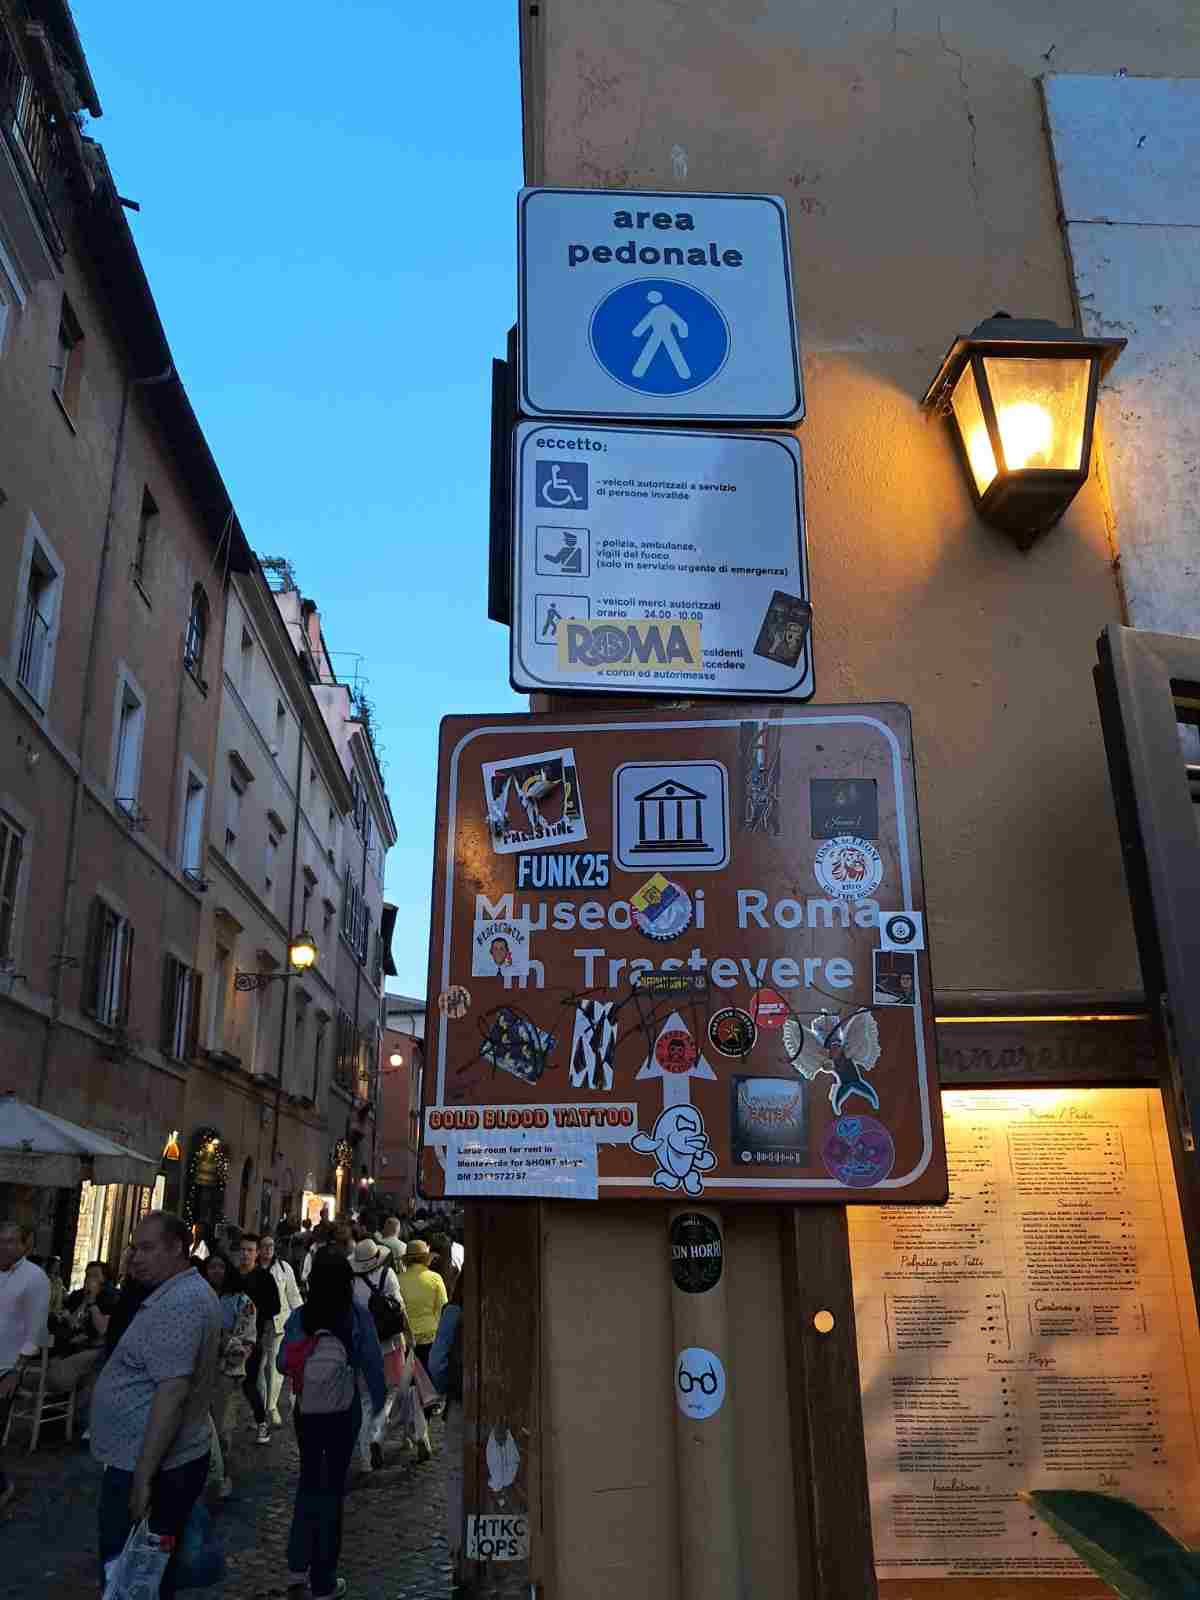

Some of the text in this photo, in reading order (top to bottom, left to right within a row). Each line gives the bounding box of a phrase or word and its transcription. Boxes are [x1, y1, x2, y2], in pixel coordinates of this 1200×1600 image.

[613, 209, 695, 230] area
[567, 241, 744, 267] pedonale
[536, 437, 608, 452] eccetto:
[603, 479, 634, 487] veicoli
[638, 480, 688, 490] autorizzati
[699, 482, 737, 492] servizio
[596, 488, 690, 500] di persone invalide
[602, 539, 638, 549] polizia,
[597, 550, 670, 560] vigili del fuoco
[596, 559, 789, 577] (solo in servizio urgente di emergenza)
[603, 597, 635, 607] veicoli
[639, 598, 666, 607] merci
[670, 600, 720, 609] autorizzati
[597, 609, 626, 618] orario
[567, 624, 694, 666] ROMA
[517, 853, 609, 888] FUNK25
[475, 894, 632, 931] Museo
[736, 889, 880, 929] Roma
[483, 1108, 549, 1128] BLOOD
[553, 1107, 634, 1127] TATTOO
[544, 1145, 553, 1153] in
[511, 1159, 522, 1168] for
